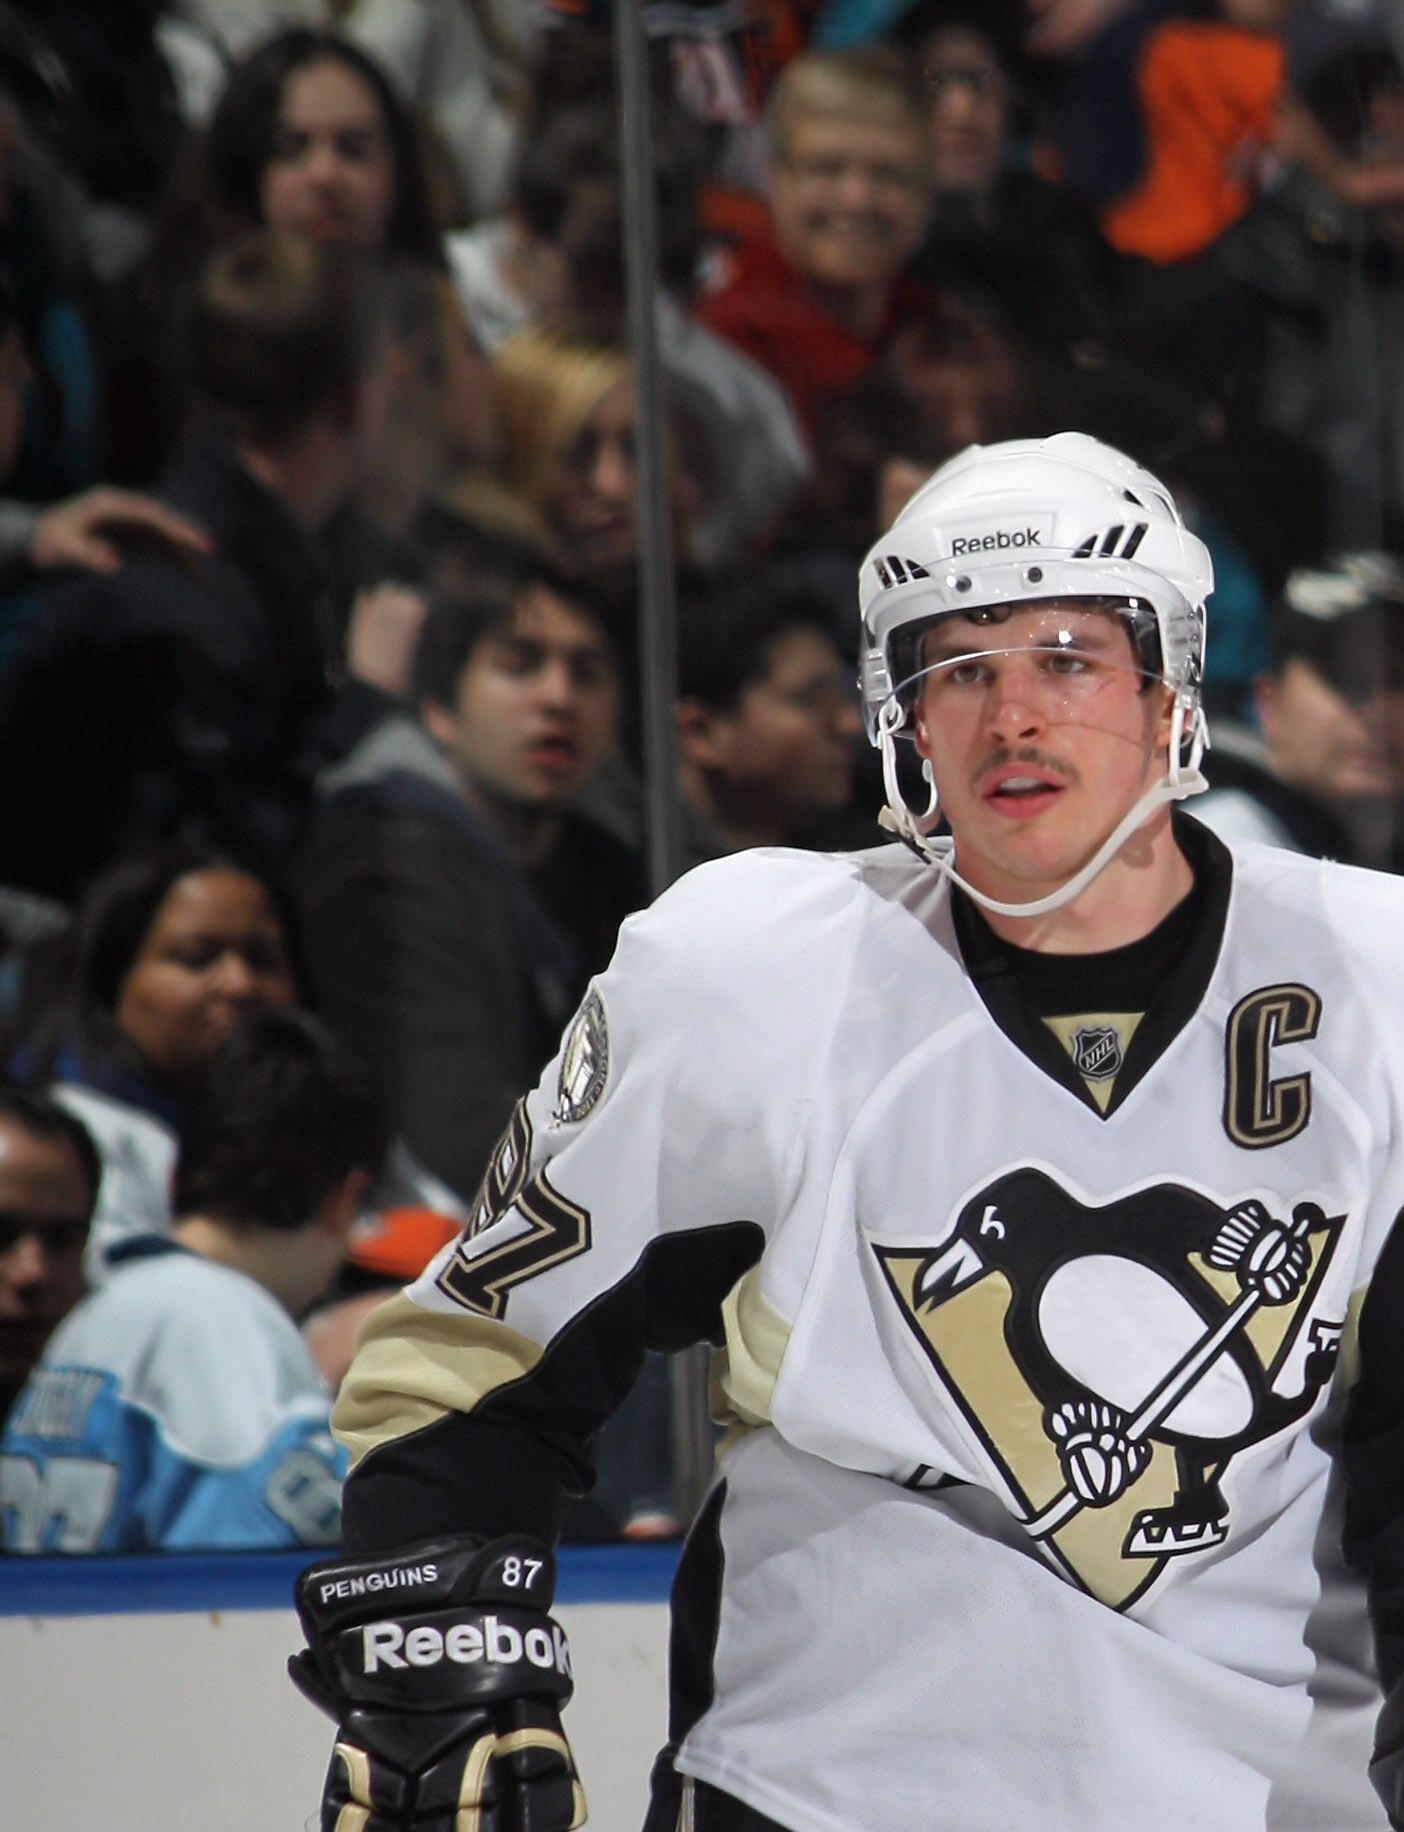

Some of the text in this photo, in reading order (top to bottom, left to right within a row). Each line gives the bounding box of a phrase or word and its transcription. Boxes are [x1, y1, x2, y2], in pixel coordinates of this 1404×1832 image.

[951, 527, 1041, 556] Reebok
[1084, 1037, 1115, 1070] NHL
[1222, 982, 1322, 1151] C
[319, 1555, 544, 1605] PENGUINS 87
[361, 1614, 573, 1680] Reebok
